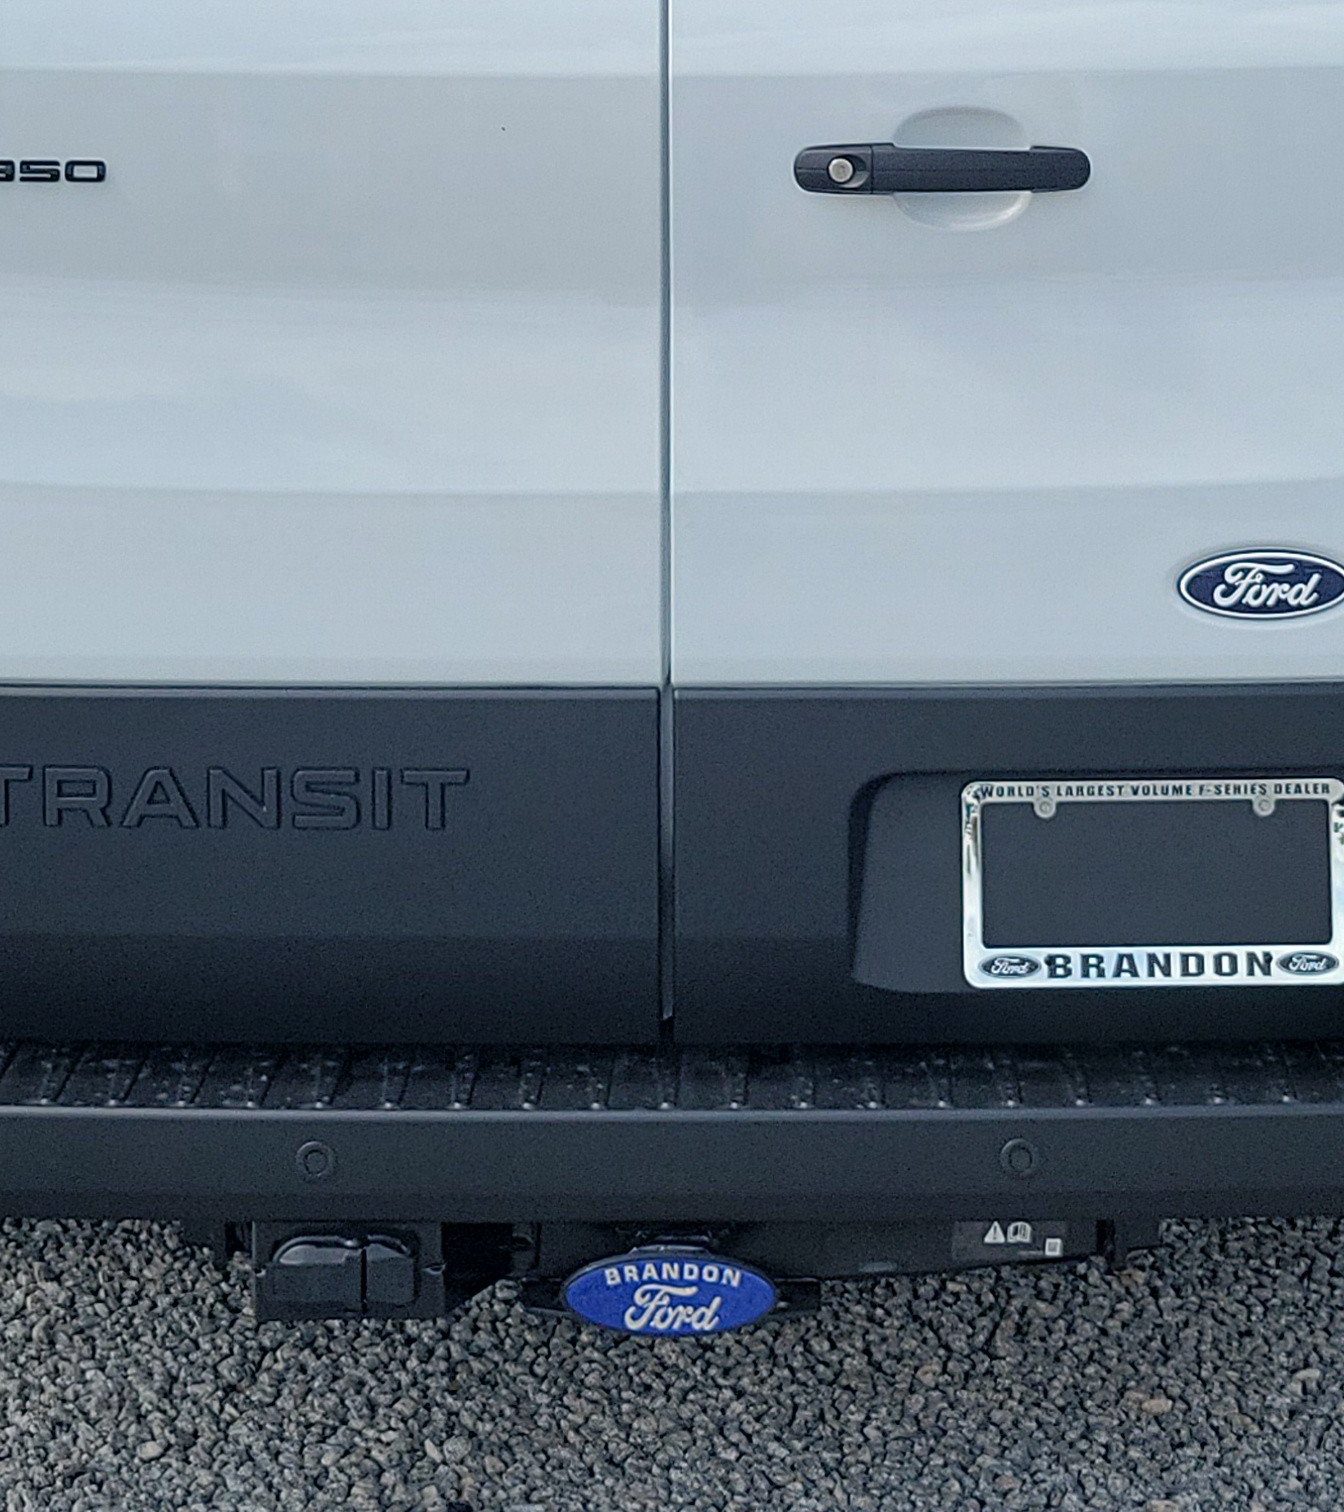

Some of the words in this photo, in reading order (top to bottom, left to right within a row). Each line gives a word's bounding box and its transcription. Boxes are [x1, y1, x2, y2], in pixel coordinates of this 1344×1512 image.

[1213, 562, 1322, 607] Ford
[980, 784, 1050, 798] WORLD'S
[1057, 785, 1125, 797] LARGEST
[1131, 784, 1192, 796] VOLUME
[1198, 783, 1267, 795] F-SERIES
[1273, 782, 1331, 795] DEALER
[991, 957, 1030, 974] Ford
[1044, 952, 1274, 979] BRANDON
[1289, 954, 1326, 972] Ford
[605, 1262, 742, 1287] BRANDON
[624, 1284, 723, 1331] Ford
